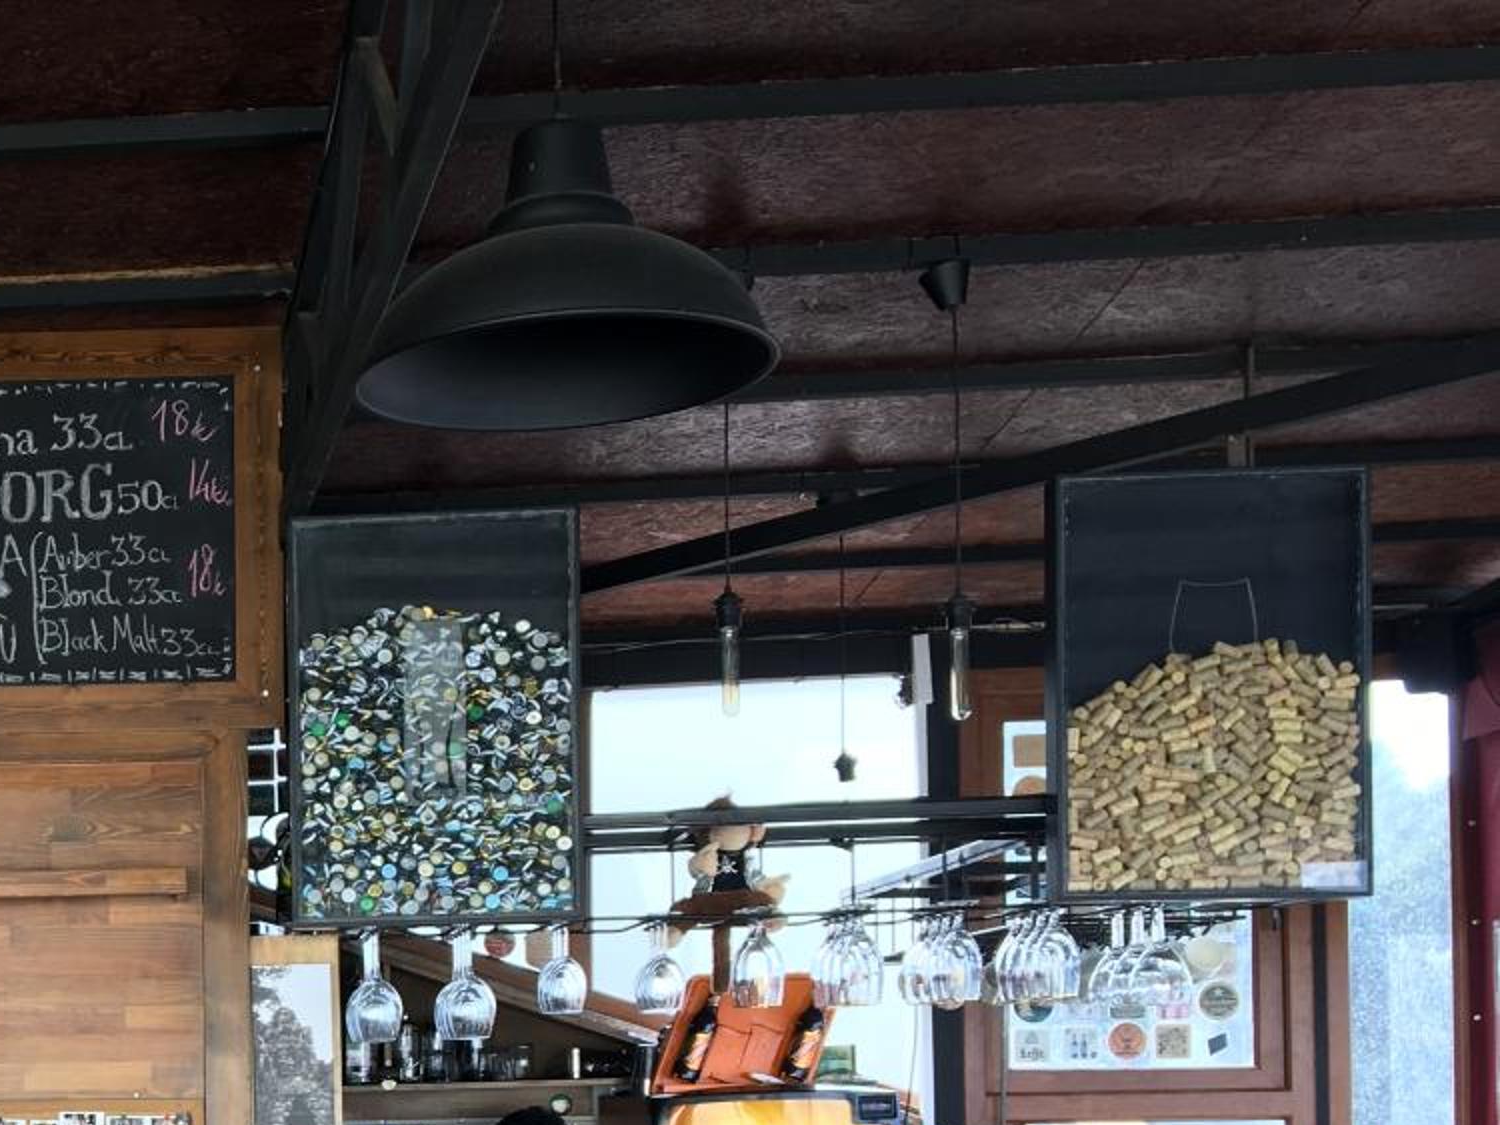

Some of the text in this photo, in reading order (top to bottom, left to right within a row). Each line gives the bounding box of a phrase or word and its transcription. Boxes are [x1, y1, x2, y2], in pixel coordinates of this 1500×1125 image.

[39, 569, 123, 612] Blond
[40, 616, 108, 657] Black
[111, 612, 162, 655] Malt
